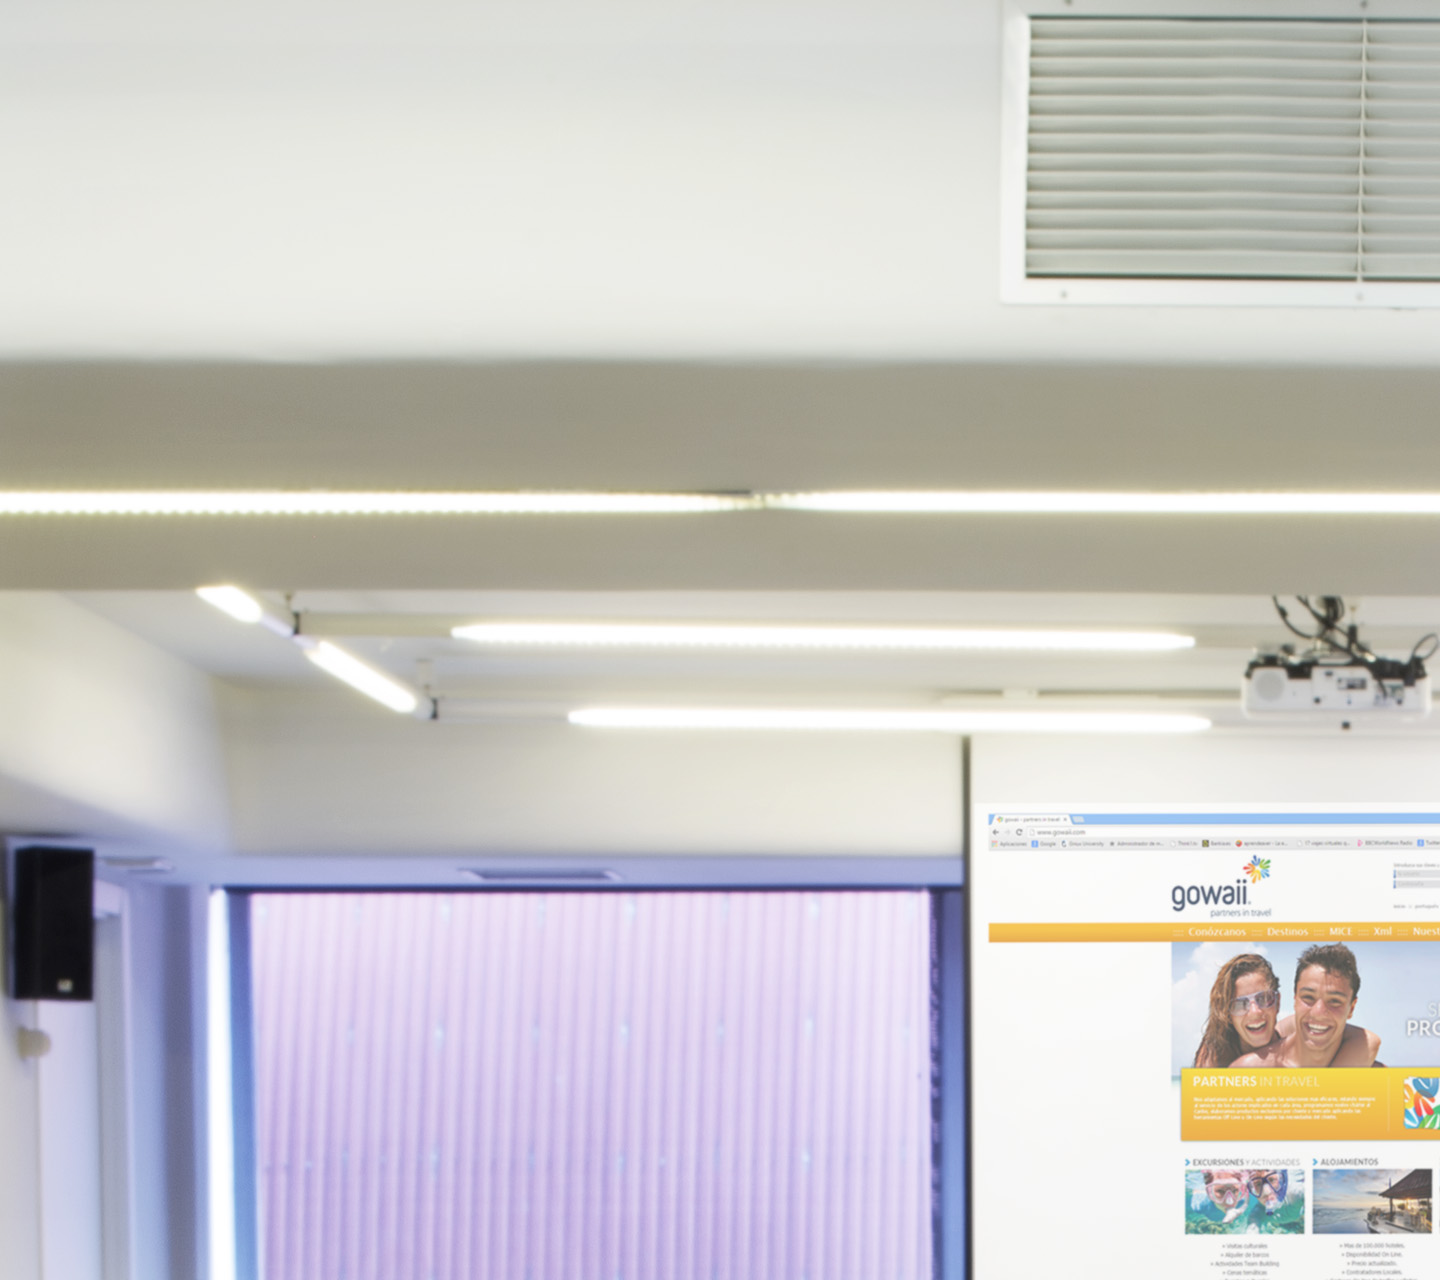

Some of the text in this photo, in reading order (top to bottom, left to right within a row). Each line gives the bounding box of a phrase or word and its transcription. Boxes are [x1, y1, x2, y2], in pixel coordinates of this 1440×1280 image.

[1040, 840, 1056, 848] Google
[1171, 879, 1248, 912] gowaii
[1210, 908, 1241, 918] partners
[1251, 908, 1272, 917] travel
[1188, 927, 1246, 936] Conózcanos
[1267, 927, 1309, 936] Destinos
[1329, 927, 1352, 936] MICE
[1373, 927, 1392, 936] Xml
[1193, 1076, 1320, 1087] PARTNERS IN TRAVEL
[1193, 1158, 1244, 1166] EXCURSIONES
[1251, 1158, 1301, 1166] ACTIVIDADES
[1320, 1158, 1379, 1166] ALOJAMIENTOS
